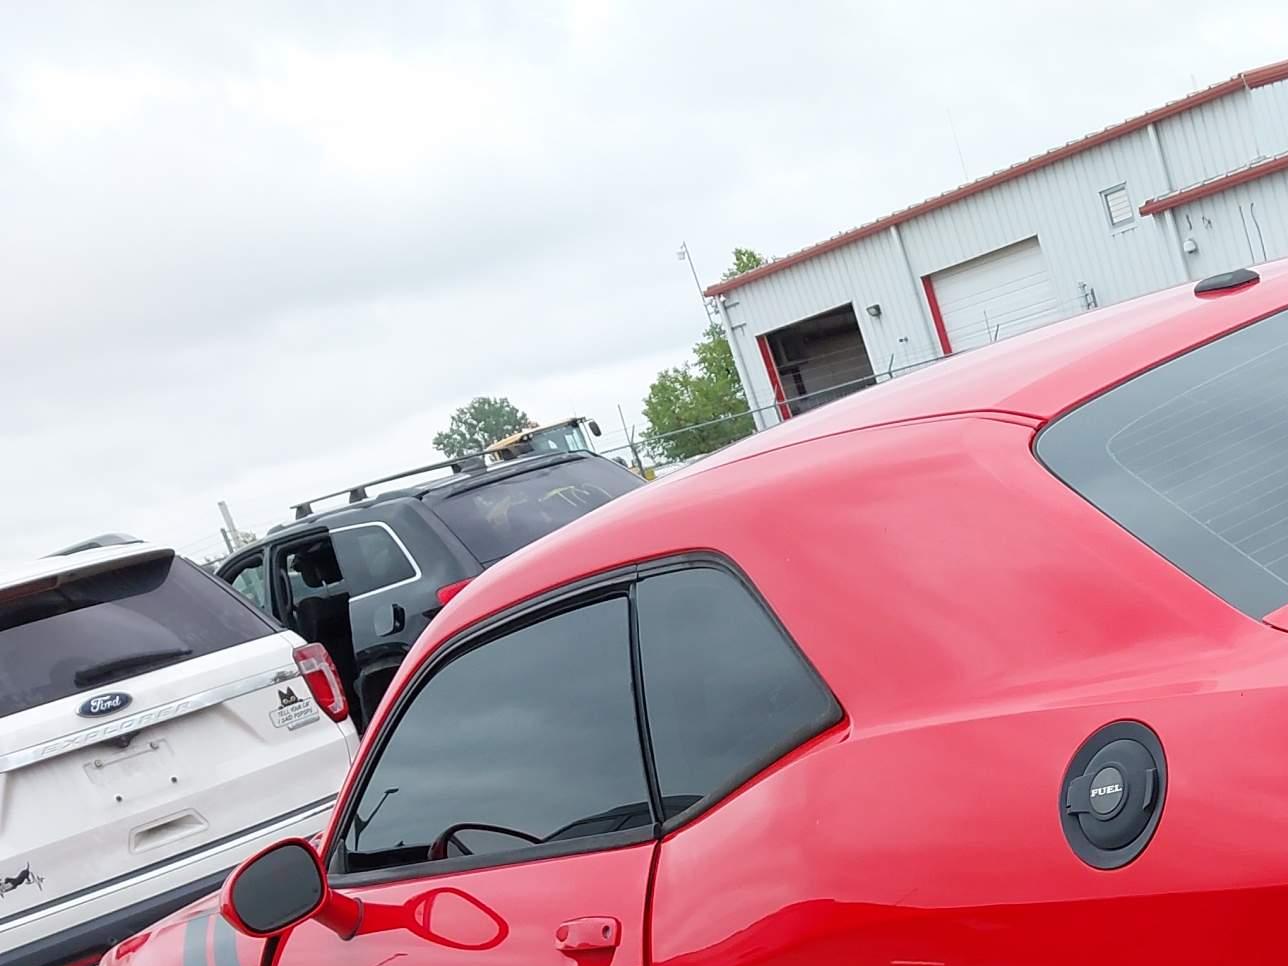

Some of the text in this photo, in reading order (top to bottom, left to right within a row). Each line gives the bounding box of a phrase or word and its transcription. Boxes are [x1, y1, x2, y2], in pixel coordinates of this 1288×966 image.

[89, 695, 122, 713] Ford
[40, 700, 194, 756] EXPLORER
[1090, 783, 1123, 798] FUEL
